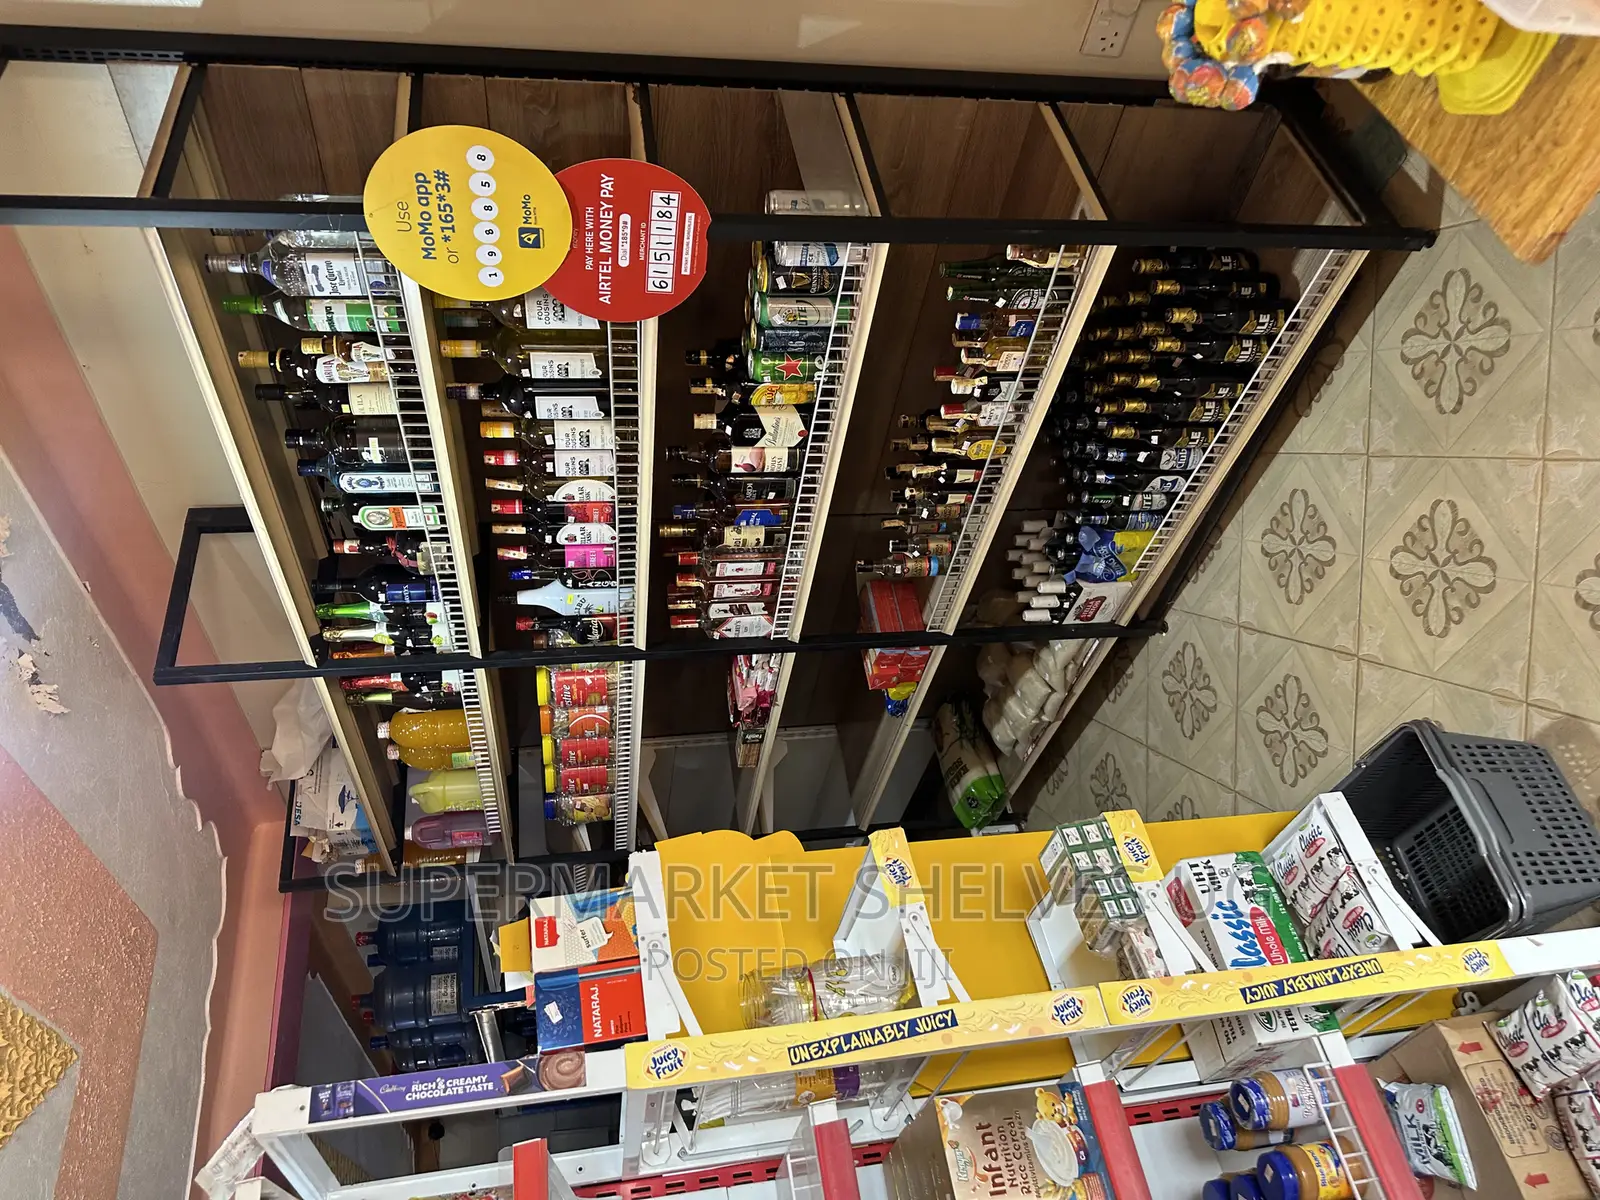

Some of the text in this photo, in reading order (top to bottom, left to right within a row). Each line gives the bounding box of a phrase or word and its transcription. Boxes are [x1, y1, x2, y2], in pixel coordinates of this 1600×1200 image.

[396, 202, 412, 232] Use
[413, 171, 437, 260] MoMo app
[522, 194, 533, 226] MoMo
[585, 206, 594, 271] PAY HERE WITH
[598, 173, 615, 305] AIRTEL MONEY PAY
[638, 229, 648, 261] MERCHANT
[444, 248, 460, 264] or
[619, 248, 629, 262] Dial
[535, 299, 544, 321] FOUR
[541, 292, 552, 326] COUSINS
[1176, 447, 1189, 470] Club
[1130, 837, 1152, 863] Fruit
[1297, 824, 1325, 853] Classic
[1122, 843, 1147, 869] Juicy
[884, 863, 907, 888] Juicy
[892, 857, 913, 883] Fruit
[1187, 860, 1212, 895] UHT
[1200, 858, 1224, 893] MILK
[579, 928, 592, 949] surfer
[1209, 900, 1268, 967] lassic
[1255, 914, 1288, 967] Whole Milk
[1462, 948, 1481, 970] Fruit
[1469, 953, 1491, 975] Juicy
[1122, 985, 1146, 1006] Fruit
[1245, 960, 1383, 1005] UNEXPLAINABLY JUICY
[590, 987, 603, 1038] NATARAJ
[1052, 996, 1077, 1018] Juicy
[1059, 1004, 1084, 1027] Fruit
[1129, 994, 1152, 1014] Juicy
[789, 1009, 955, 1065] UNEXPLAINABLY JUICY
[650, 1047, 680, 1070] Juicy
[655, 1057, 685, 1080] Fruit
[379, 1082, 407, 1095] Cadbury
[404, 1082, 495, 1101] CHOCOLATE TASTE
[411, 1074, 488, 1095] RICH & CREAMY
[1012, 1109, 1023, 1121] Zn
[1404, 1114, 1431, 1165] MILK
[974, 1121, 1008, 1198] Infant
[996, 1125, 1020, 1189] Nutrition
[1003, 1116, 1033, 1196] Rice Cereal
[1078, 1149, 1087, 1162] Ca
[1307, 1149, 1328, 1187] Blue Band
[1022, 1141, 1042, 1199] Multivitamins
